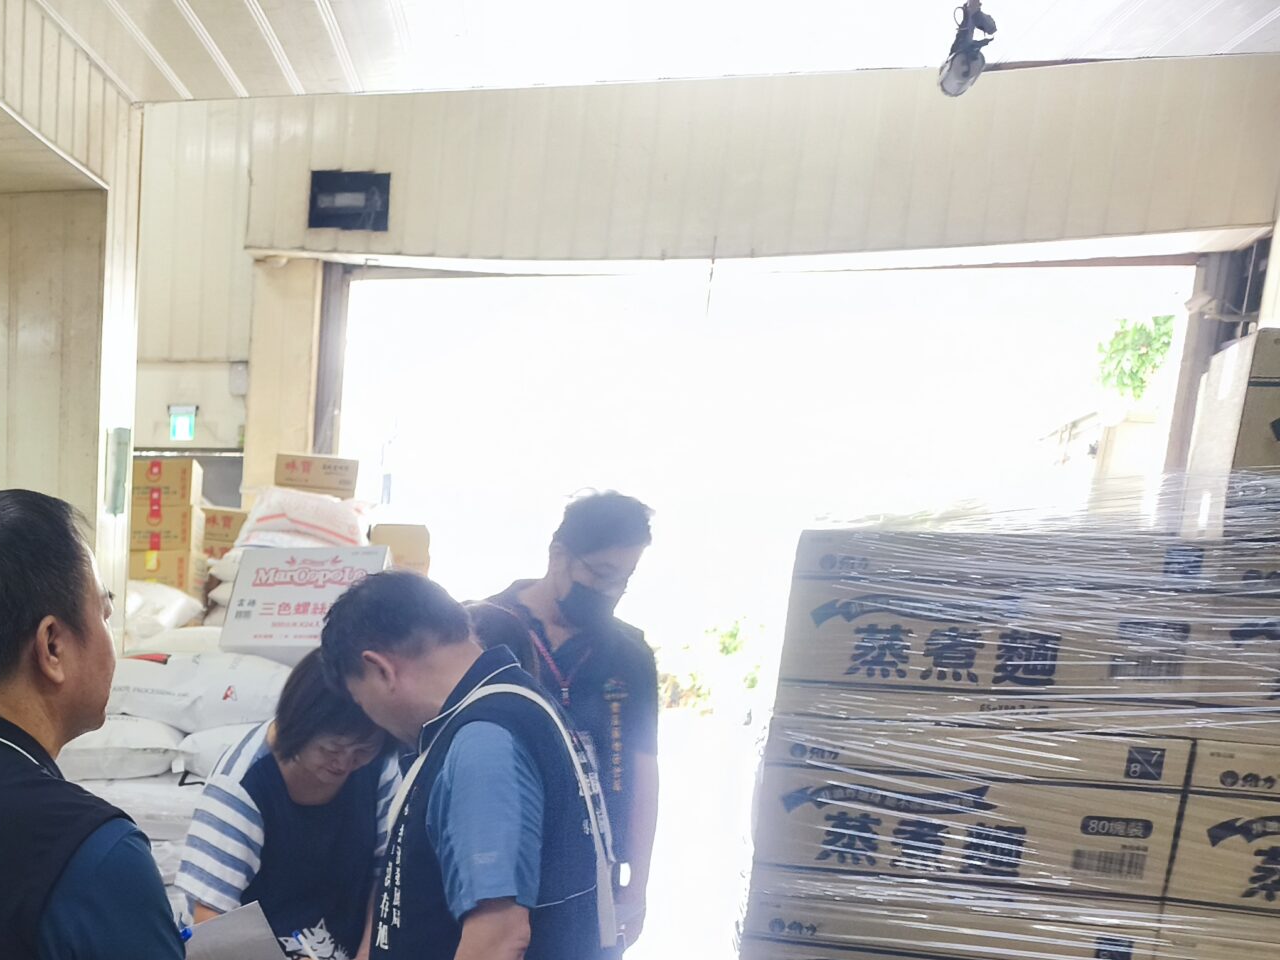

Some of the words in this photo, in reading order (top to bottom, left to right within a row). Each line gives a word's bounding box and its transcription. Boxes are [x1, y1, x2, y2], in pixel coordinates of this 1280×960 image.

[259, 601, 333, 616] 三色螺絲
[843, 622, 1063, 686] 蒸煮麵
[815, 811, 1027, 877] 蒸煮麵
